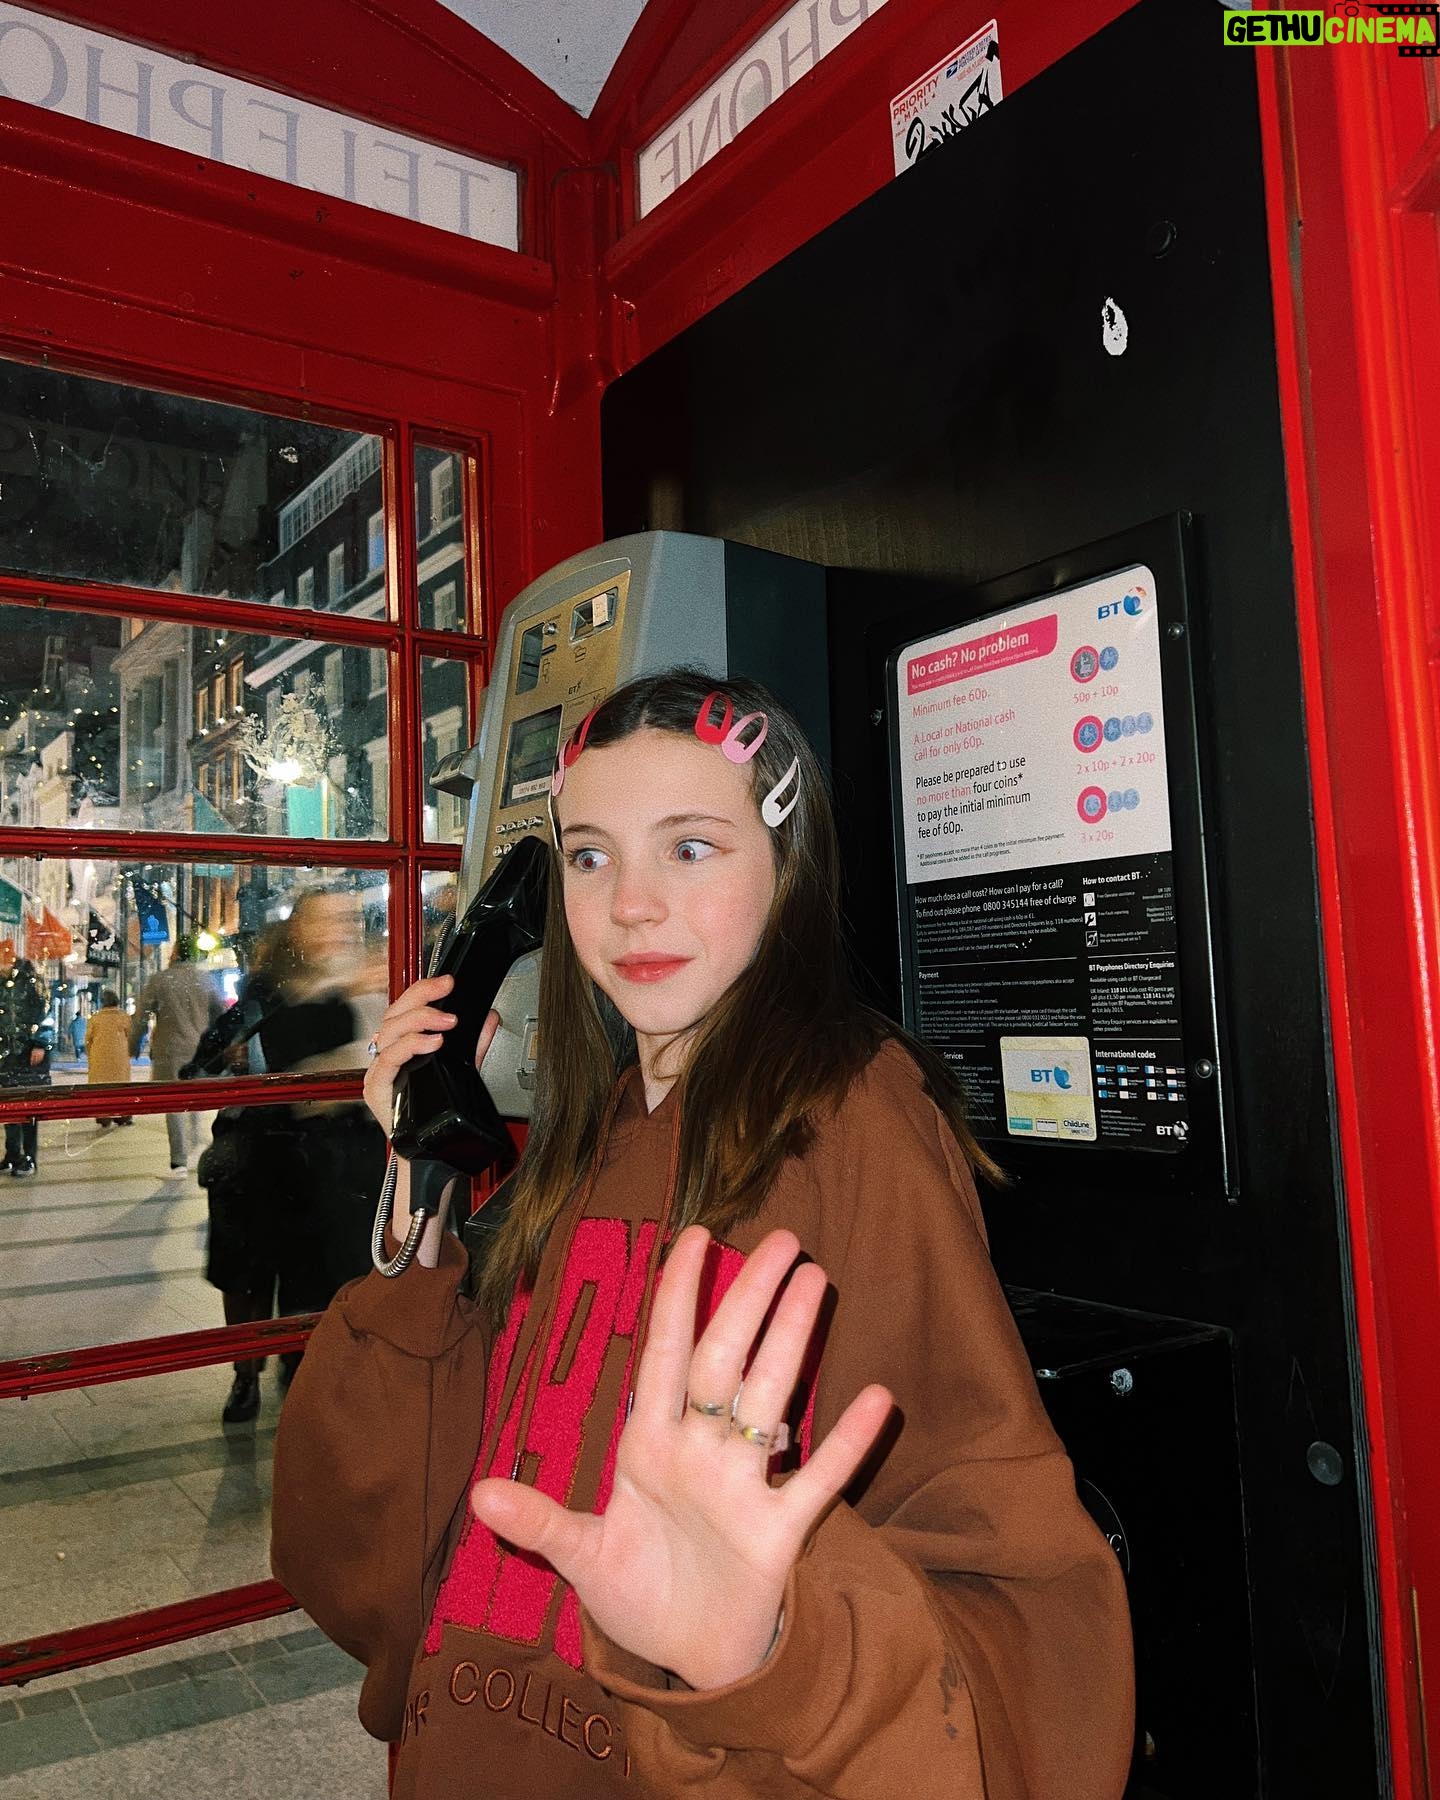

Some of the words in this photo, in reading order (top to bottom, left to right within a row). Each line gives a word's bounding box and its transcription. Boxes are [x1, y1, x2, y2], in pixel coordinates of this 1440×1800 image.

[892, 75, 938, 119] PRIORITY
[904, 100, 930, 122] MAIL
[1098, 601, 1122, 620] BT
[912, 664, 925, 679] No
[928, 652, 957, 673] cash?
[961, 648, 976, 664] No
[979, 633, 1029, 661] problem
[912, 700, 952, 718] Minimum
[953, 694, 966, 706] fee
[969, 688, 990, 702] 60p.
[1073, 692, 1090, 704] 50p
[1101, 686, 1119, 697] 10p
[914, 734, 920, 745] A
[922, 728, 943, 743] Local
[945, 727, 953, 737] or
[955, 714, 992, 734] National
[994, 709, 1015, 724] cash
[914, 750, 928, 761] call
[929, 746, 940, 757] for
[944, 742, 961, 754] only
[964, 736, 984, 750] 60p.
[916, 776, 941, 789] Please
[944, 772, 953, 783] be
[956, 760, 995, 782] prepared
[997, 761, 1007, 771] to
[1010, 757, 1026, 768] use
[1077, 763, 1082, 774] 2
[1092, 759, 1110, 772] 10p
[1121, 756, 1127, 766] 2
[1136, 752, 1156, 764] 20p
[917, 796, 926, 805] no
[928, 791, 949, 803] more
[952, 785, 971, 799] than
[973, 782, 991, 794] four
[918, 812, 926, 822] to
[928, 810, 942, 822] pay
[944, 804, 958, 817] the
[960, 801, 984, 814] initial
[987, 792, 1031, 809] minimum
[918, 826, 930, 839] fee
[932, 823, 941, 836] of
[943, 822, 963, 835] 60p.
[1081, 832, 1086, 842] 3
[1097, 830, 1114, 842] 20p
[1106, 874, 1130, 882] contact
[1131, 872, 1140, 880] BT
[915, 895, 926, 904] How
[928, 892, 942, 902] much
[943, 891, 956, 901] does
[961, 889, 971, 899] call
[973, 888, 987, 898] cost?
[989, 887, 1002, 896] How
[1004, 886, 1015, 894] can
[1020, 884, 1031, 894] pay
[1032, 882, 1042, 891] for
[1048, 879, 1064, 889] call?
[916, 910, 922, 918] To
[923, 908, 933, 917] find
[934, 908, 943, 916] out
[944, 906, 961, 916] please
[962, 904, 981, 914] phone
[983, 901, 1000, 911] 0800
[1002, 898, 1028, 909] 345144
[1030, 896, 1043, 906] free
[1044, 896, 1051, 905] of
[1052, 895, 1076, 905] charge
[918, 972, 940, 980] Payment
[1096, 964, 1123, 972] Payphones
[1095, 1050, 1136, 1058] International
[1137, 1050, 1156, 1058] codes
[1030, 1069, 1053, 1082] BT
[1064, 1120, 1090, 1128] ChildLine
[1156, 1126, 1172, 1135] BT
